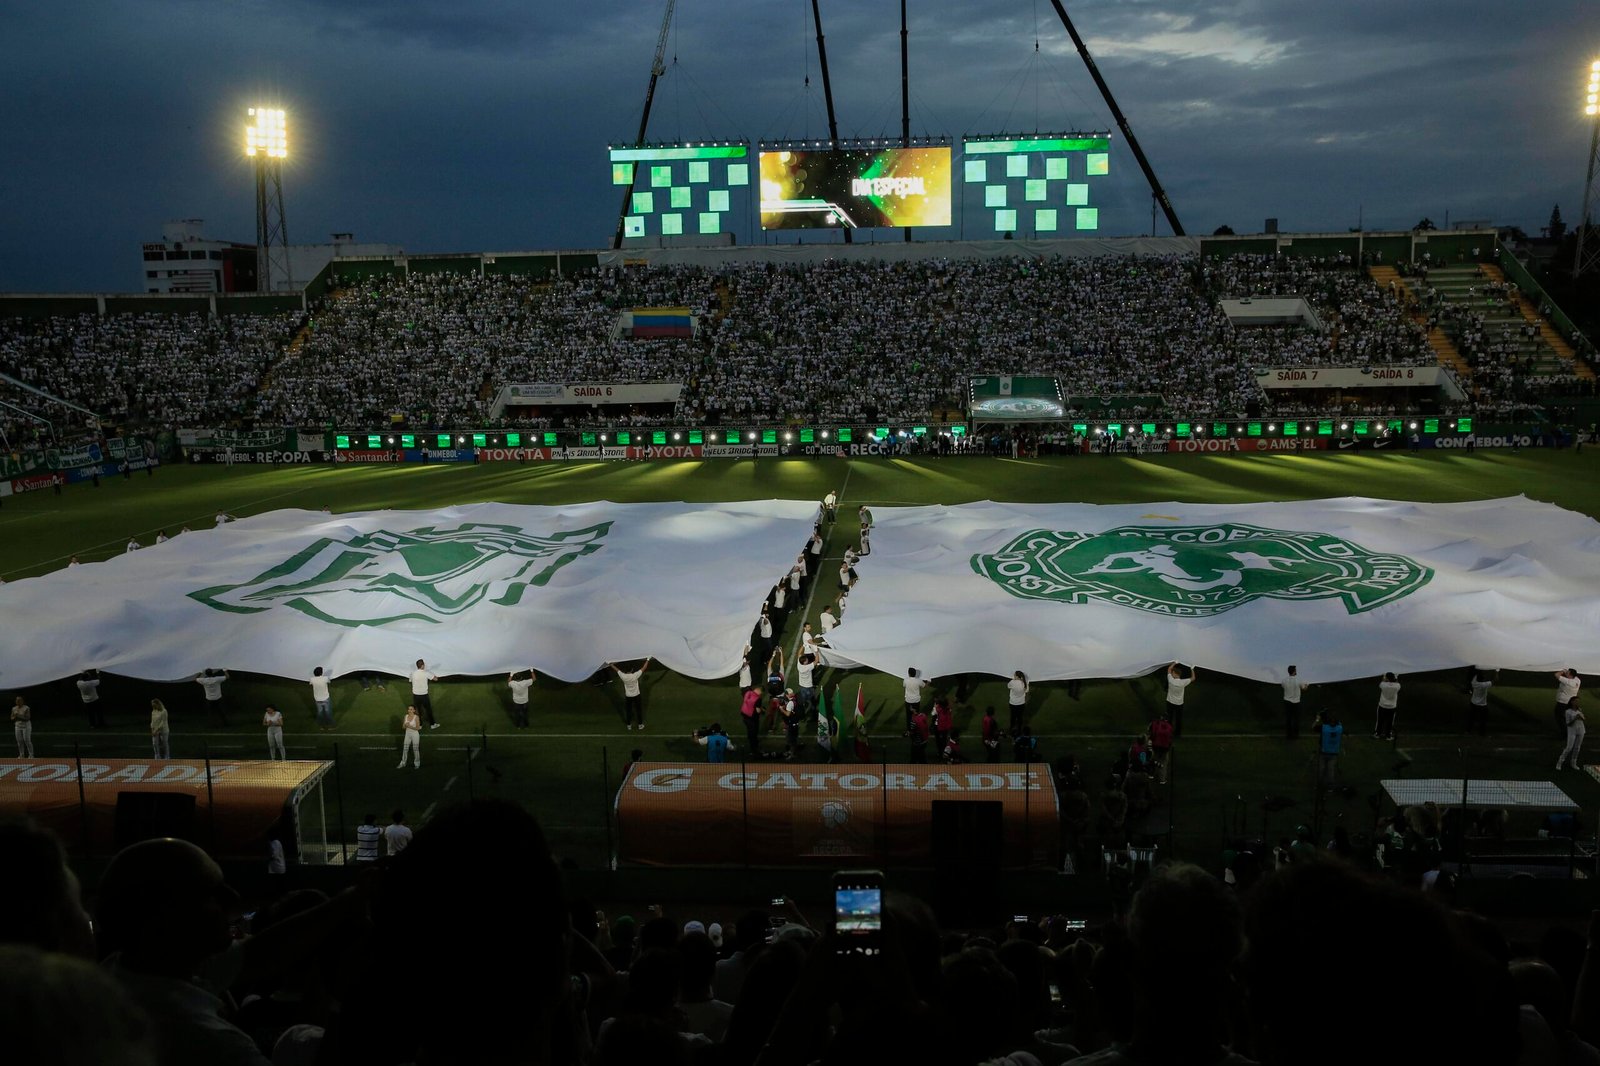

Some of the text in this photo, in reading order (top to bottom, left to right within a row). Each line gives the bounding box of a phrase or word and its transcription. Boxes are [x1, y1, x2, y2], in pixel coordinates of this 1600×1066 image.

[1277, 371, 1318, 381] SAÍDA 7
[1372, 369, 1413, 379] SAÍDA 8
[574, 386, 613, 397] SAÍDA 6
[1176, 439, 1240, 451] TOYOTA
[717, 772, 1041, 791] GATORADE
